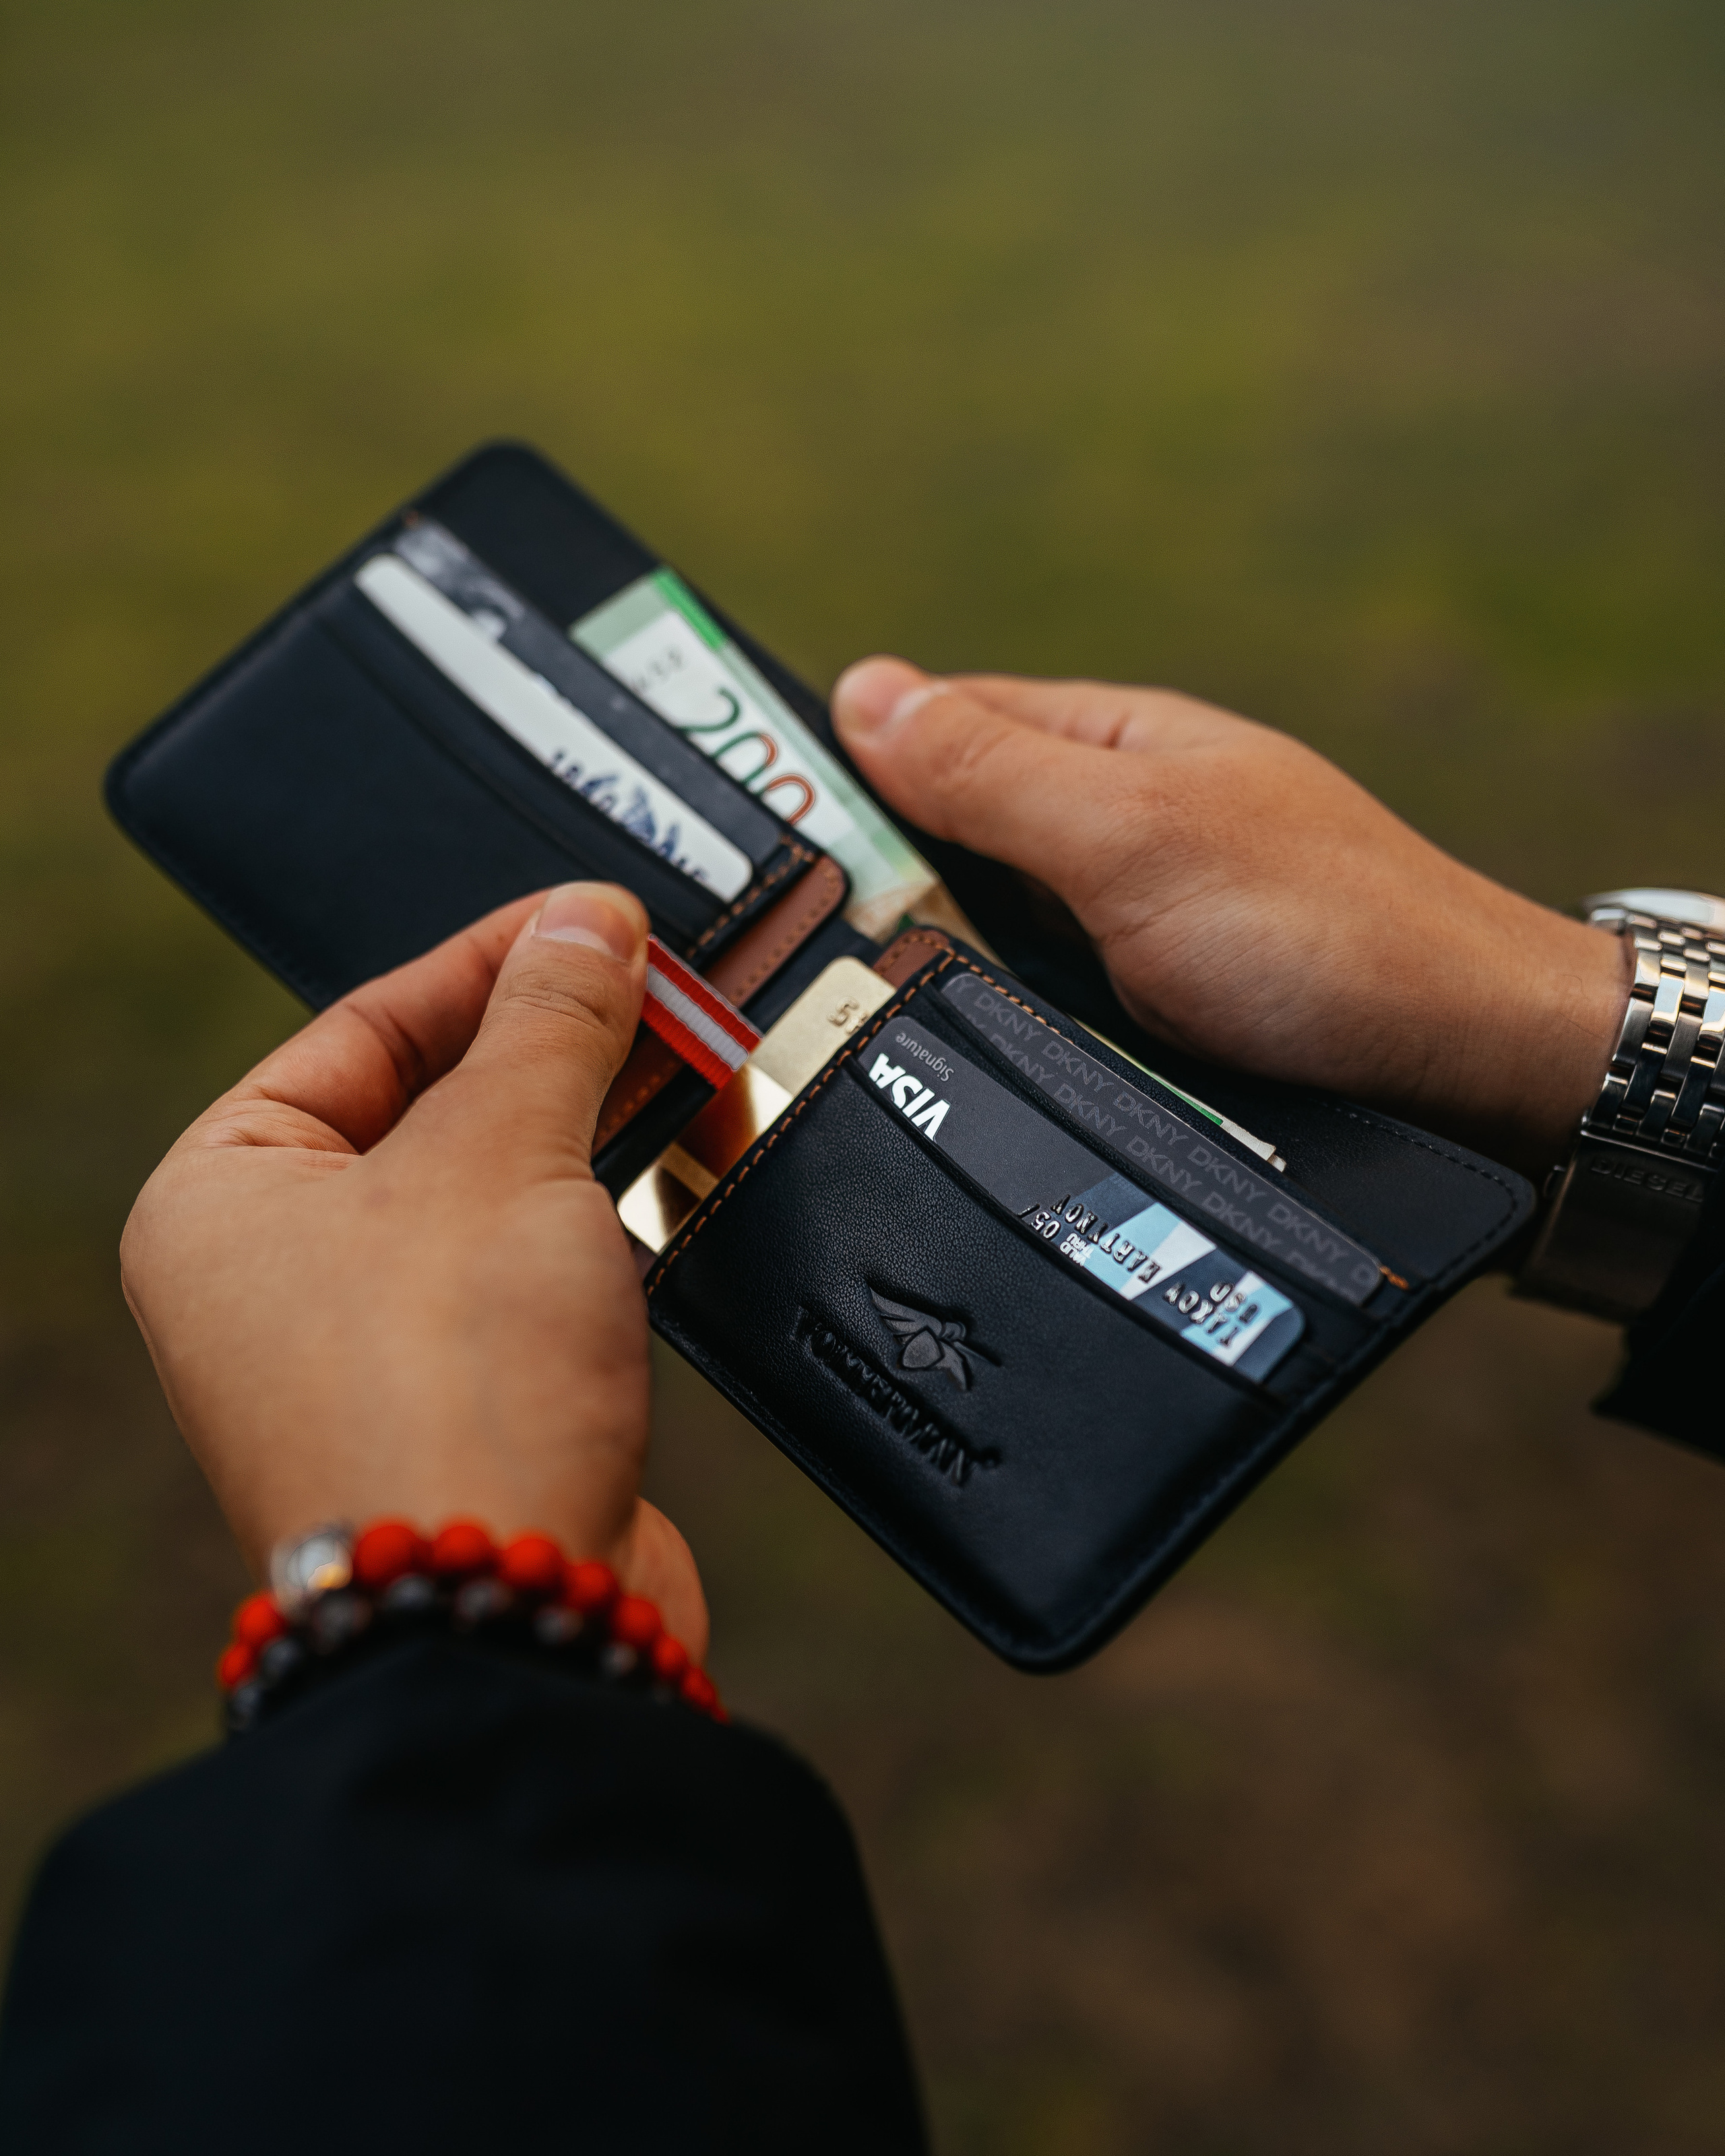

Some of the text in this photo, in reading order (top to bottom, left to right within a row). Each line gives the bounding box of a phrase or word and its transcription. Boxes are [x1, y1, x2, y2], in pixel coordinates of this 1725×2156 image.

[676, 686, 817, 826] 200
[895, 1031, 954, 1082] Signature
[868, 1052, 951, 1141] VISA
[974, 992, 1042, 1042] DKNY
[1041, 1040, 1114, 1093] DKNY
[1113, 1091, 1189, 1145] DKNY
[1187, 1144, 1268, 1203] DKNY
[1266, 1202, 1350, 1263] DKNY
[1053, 1083, 1127, 1137] DKNY
[1125, 1135, 1203, 1193] DKNY
[1201, 1191, 1282, 1250] DKNY
[1590, 1157, 1703, 1203] DIESEL
[1059, 1240, 1086, 1267] VALID
[1066, 1232, 1094, 1259] THRU
